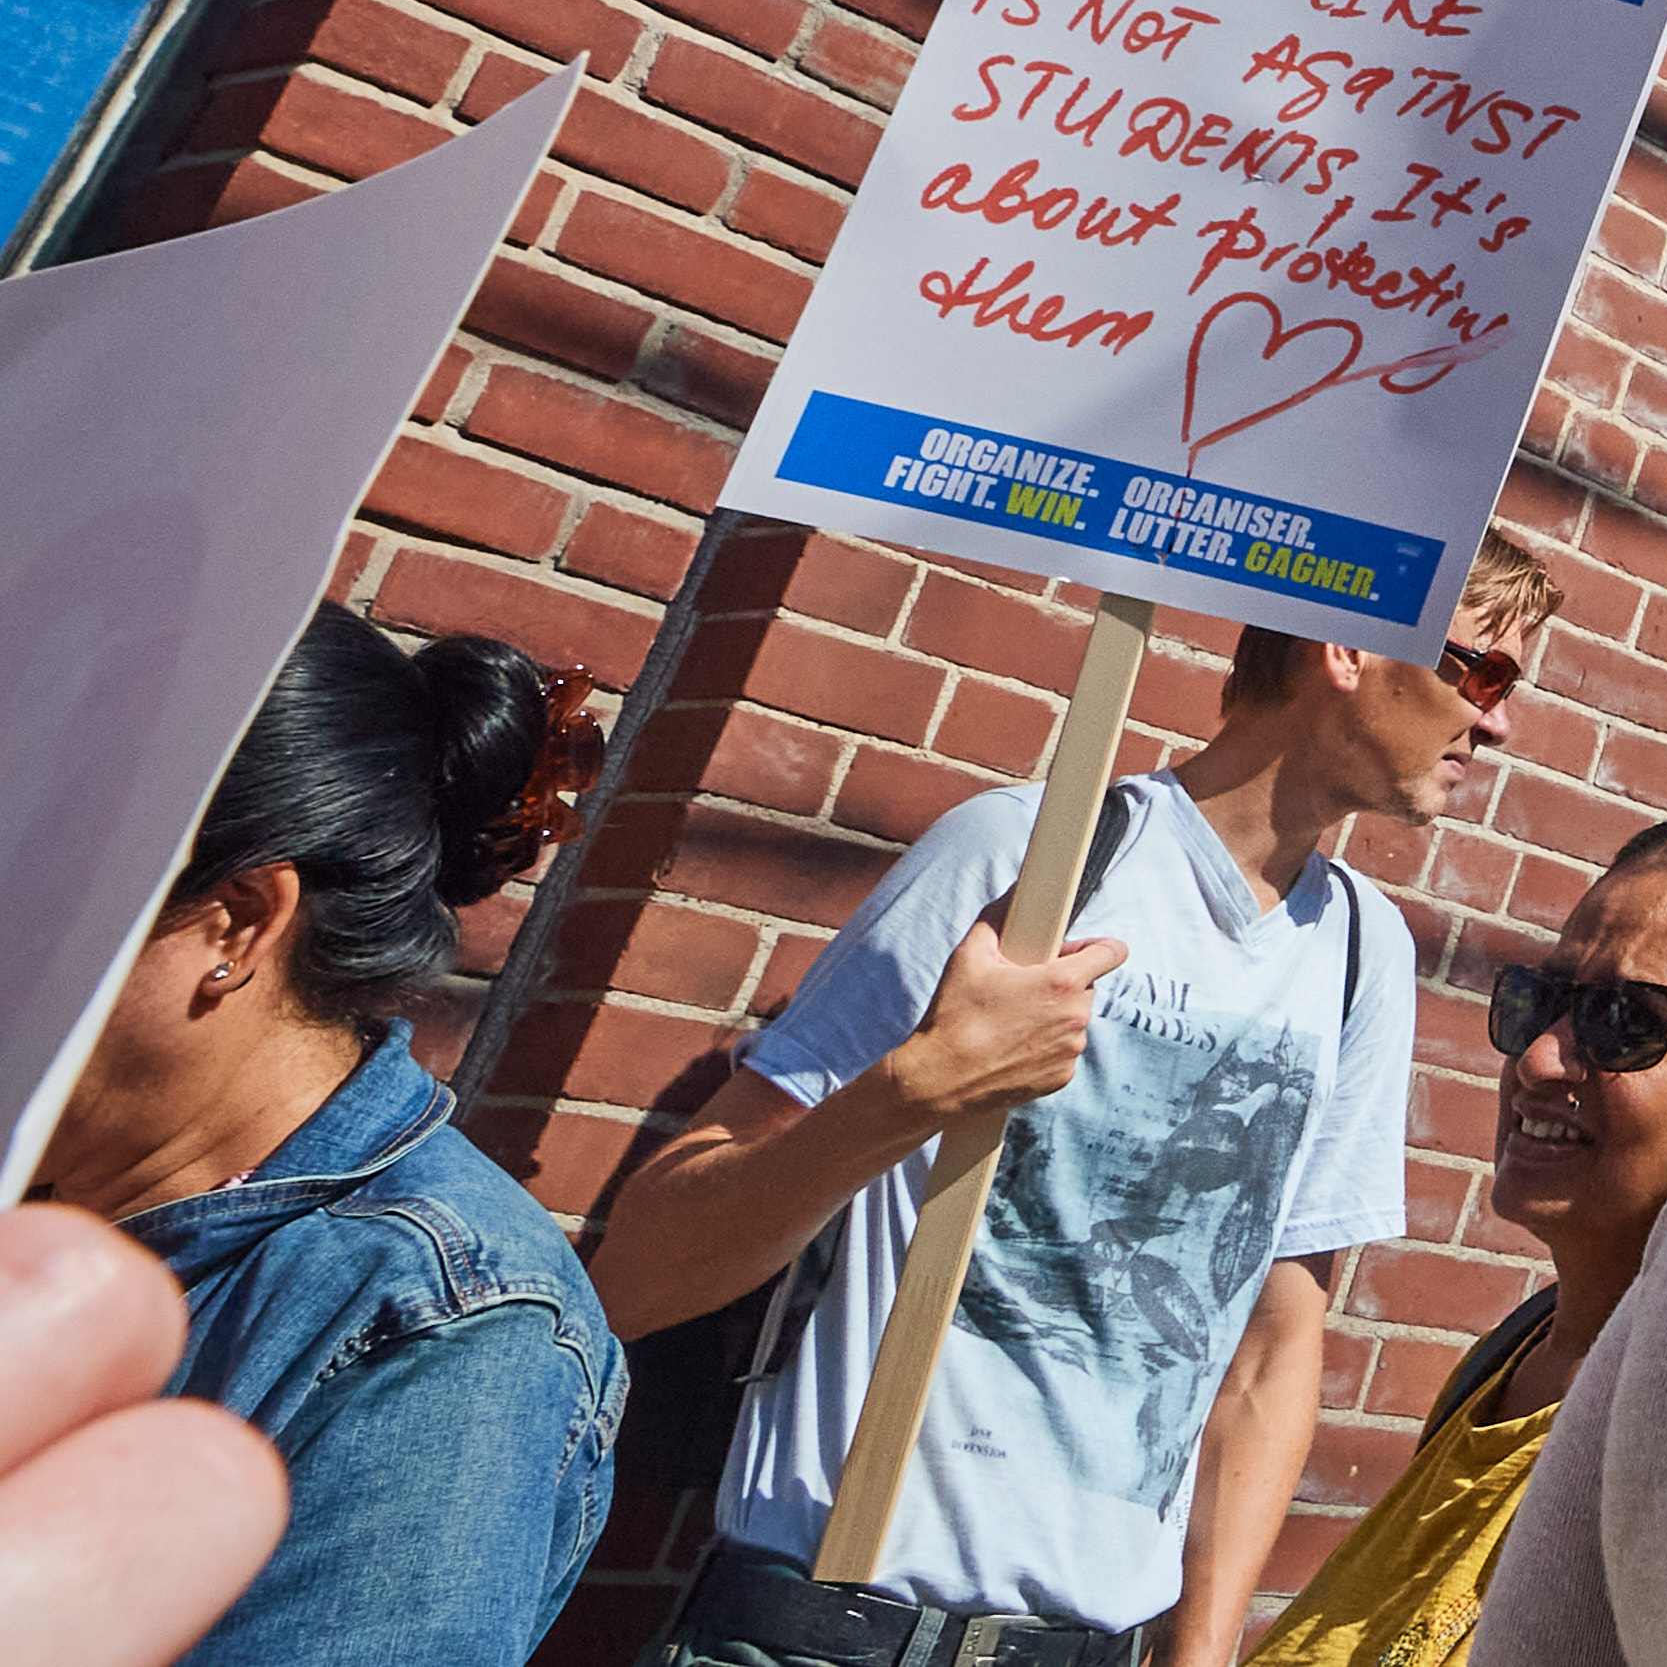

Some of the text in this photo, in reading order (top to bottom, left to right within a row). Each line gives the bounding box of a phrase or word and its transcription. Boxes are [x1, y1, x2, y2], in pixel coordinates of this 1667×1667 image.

[920, 159, 1181, 246] about
[919, 257, 1154, 356] them
[883, 455, 1086, 531] FIGHT. WIN.
[920, 427, 1100, 498] ORGANIZE.
[1122, 475, 1317, 551] ORGANISER.
[1108, 507, 1380, 602] LUTTER. GAGNER.
